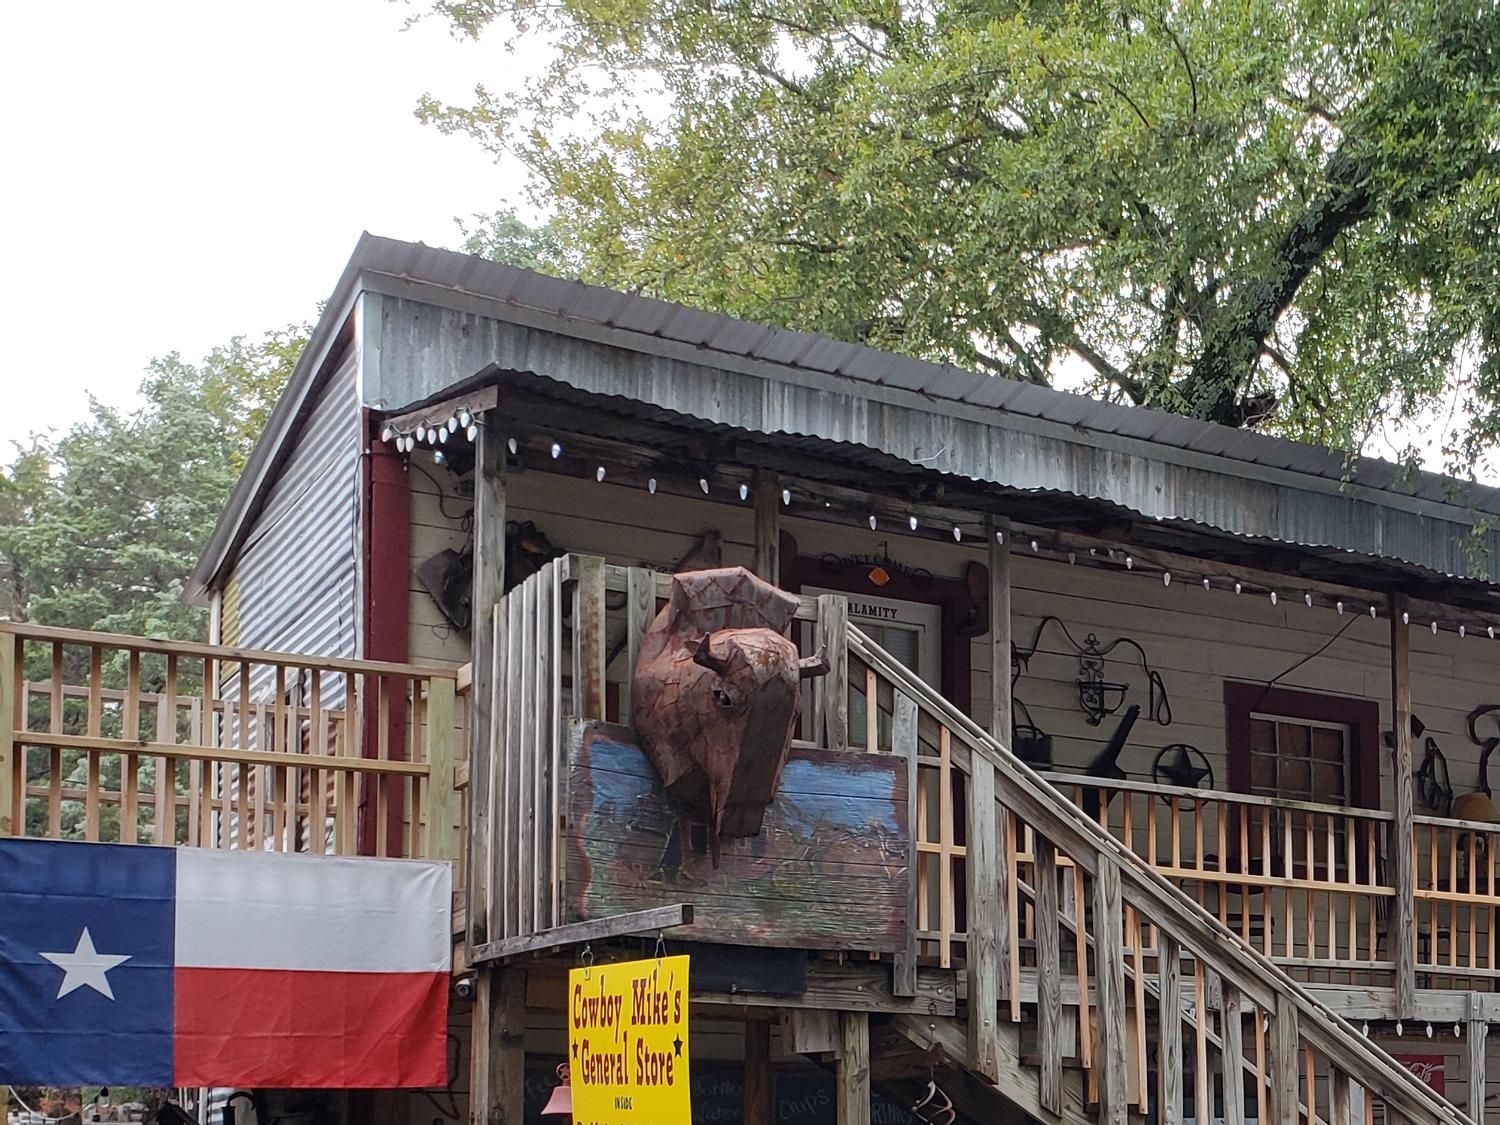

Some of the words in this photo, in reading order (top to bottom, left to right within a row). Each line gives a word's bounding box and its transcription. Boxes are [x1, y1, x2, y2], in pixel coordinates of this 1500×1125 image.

[847, 602, 898, 619] ALAMITY
[573, 974, 623, 1044] Cowboy
[631, 968, 682, 1026] Mike's
[581, 1030, 629, 1085] General
[636, 1037, 674, 1087] Store
[614, 1096, 633, 1110] INSIDE
[871, 1103, 912, 1125] RINKS
